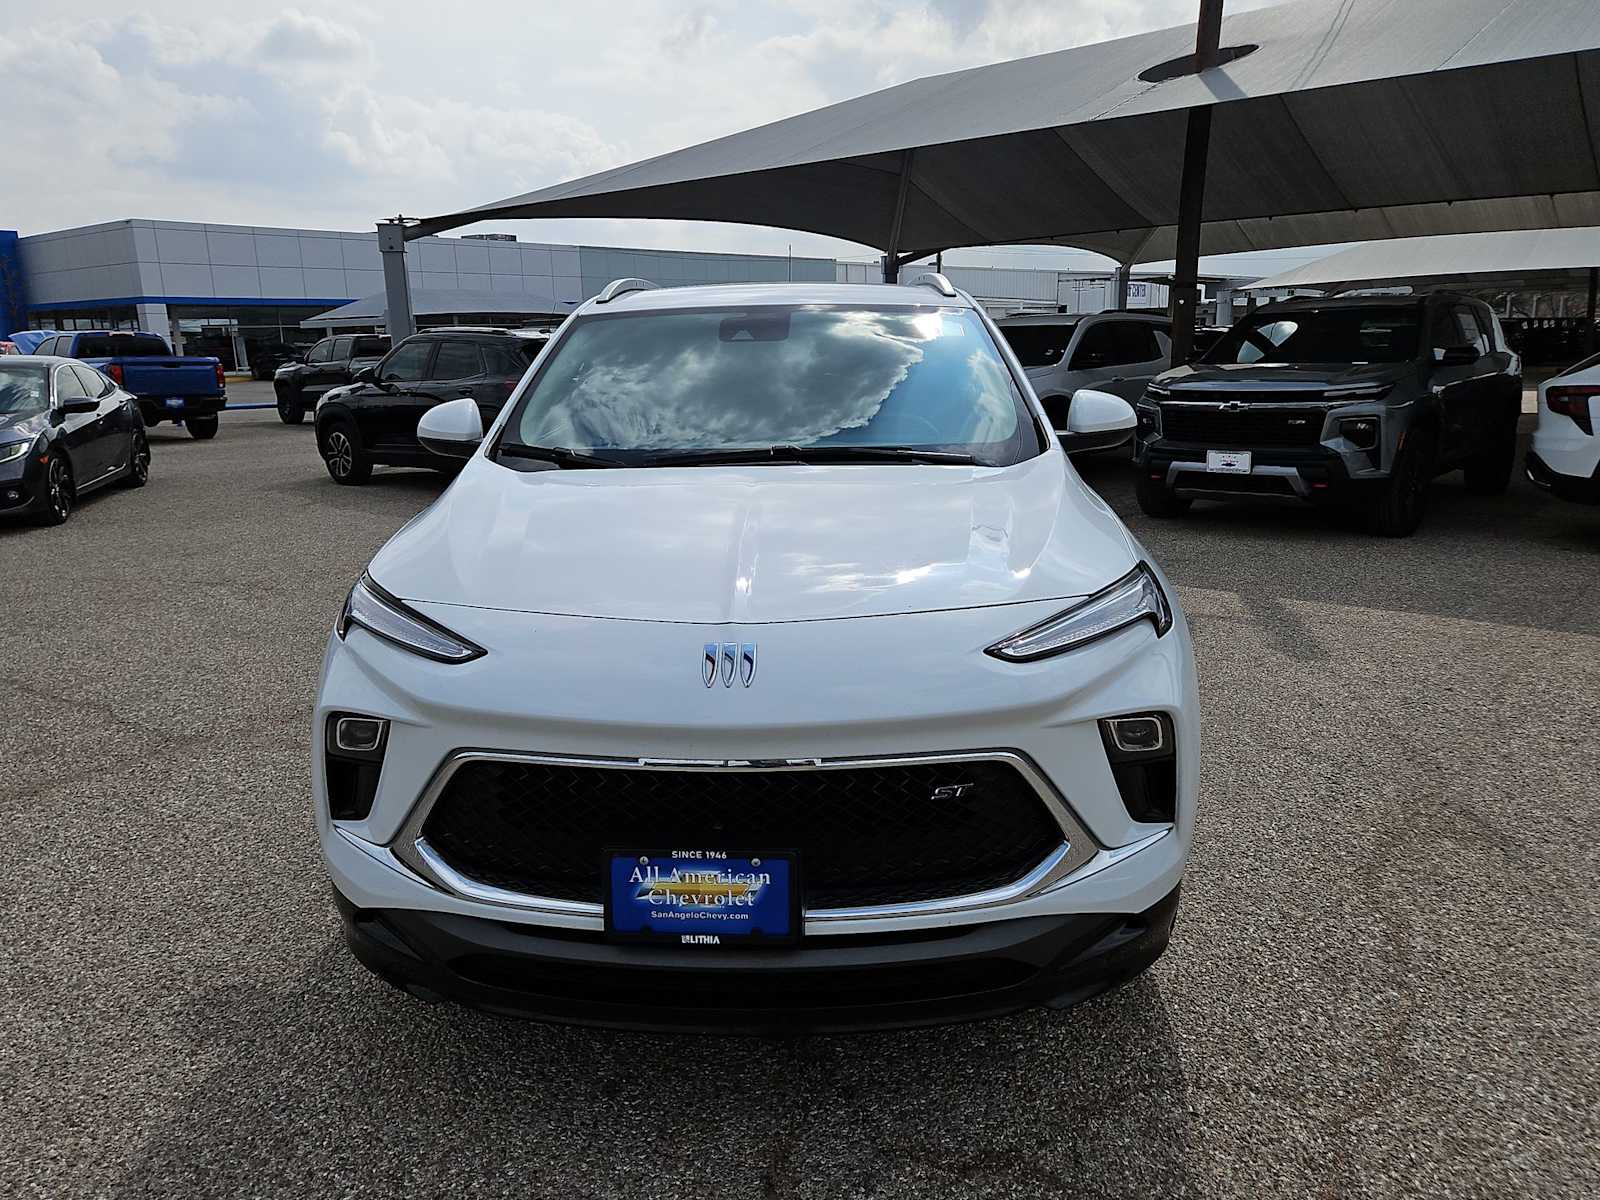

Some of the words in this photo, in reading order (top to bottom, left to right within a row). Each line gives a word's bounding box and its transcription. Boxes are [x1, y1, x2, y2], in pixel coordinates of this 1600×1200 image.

[930, 783, 975, 800] ST
[671, 850, 703, 859] SINCE
[705, 851, 727, 859] 1946
[629, 866, 660, 883] All
[669, 868, 771, 885] American
[648, 889, 755, 906] Chevrolet
[651, 911, 749, 921] SanAngeloChevy.com
[690, 934, 720, 944] LITHIA
